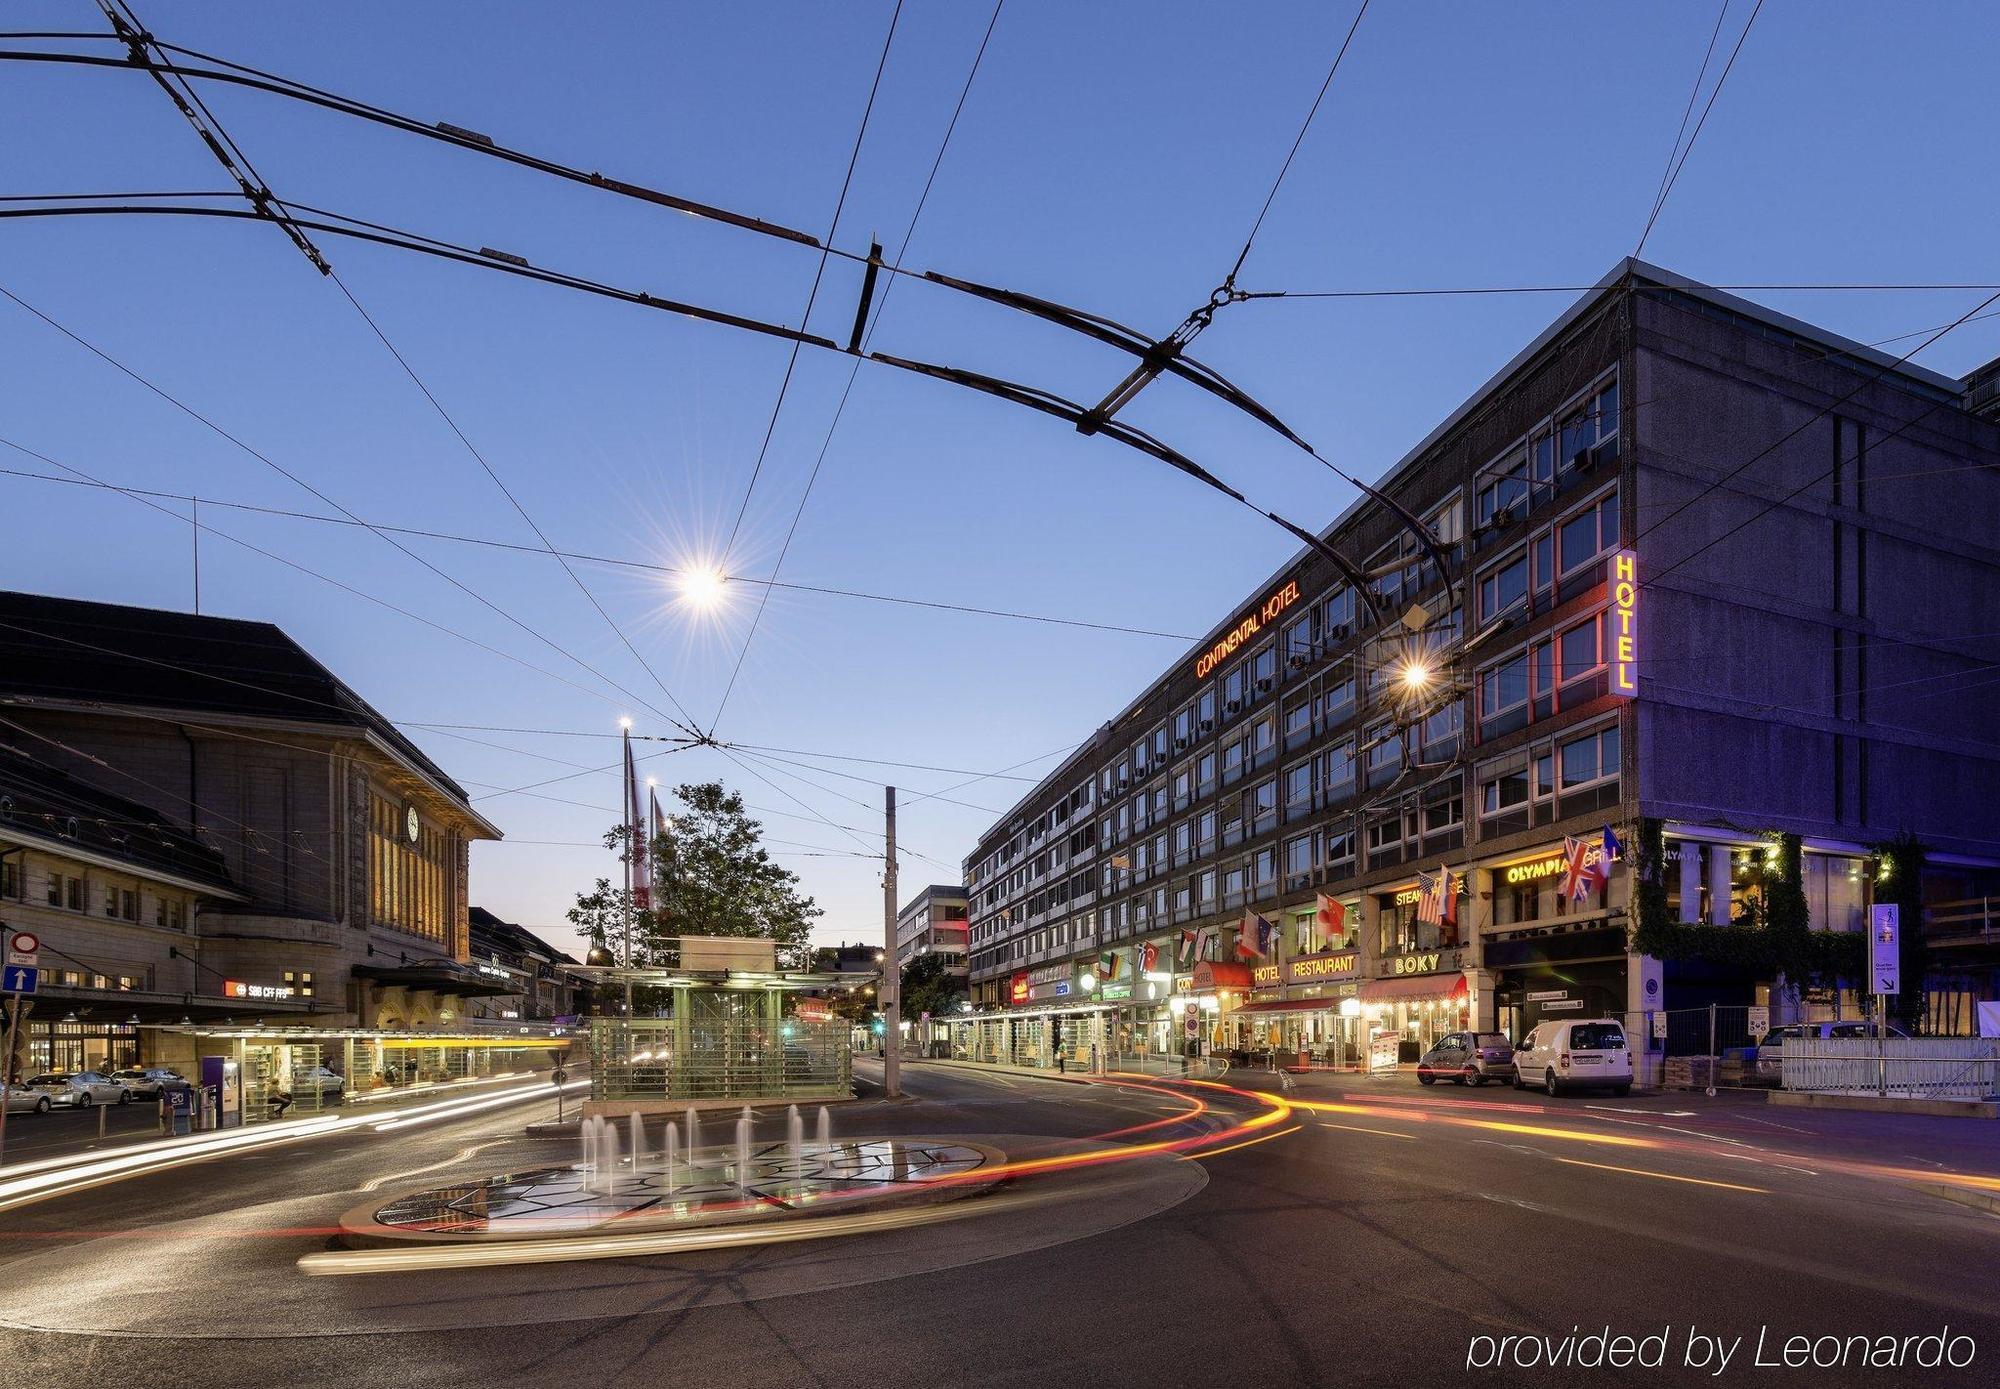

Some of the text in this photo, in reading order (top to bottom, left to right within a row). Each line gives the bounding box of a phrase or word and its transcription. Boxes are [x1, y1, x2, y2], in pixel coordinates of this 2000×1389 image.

[1197, 581, 1299, 678] CONTINENTAL HOTEL
[1616, 555, 1635, 689] HOTEL
[1507, 858, 1570, 883] OLYMPIA
[1255, 955, 1354, 981] HOTEL RESTAURANT
[1395, 954, 1439, 974] BOKY
[248, 985, 262, 997] SBB
[263, 987, 275, 998] CFF
